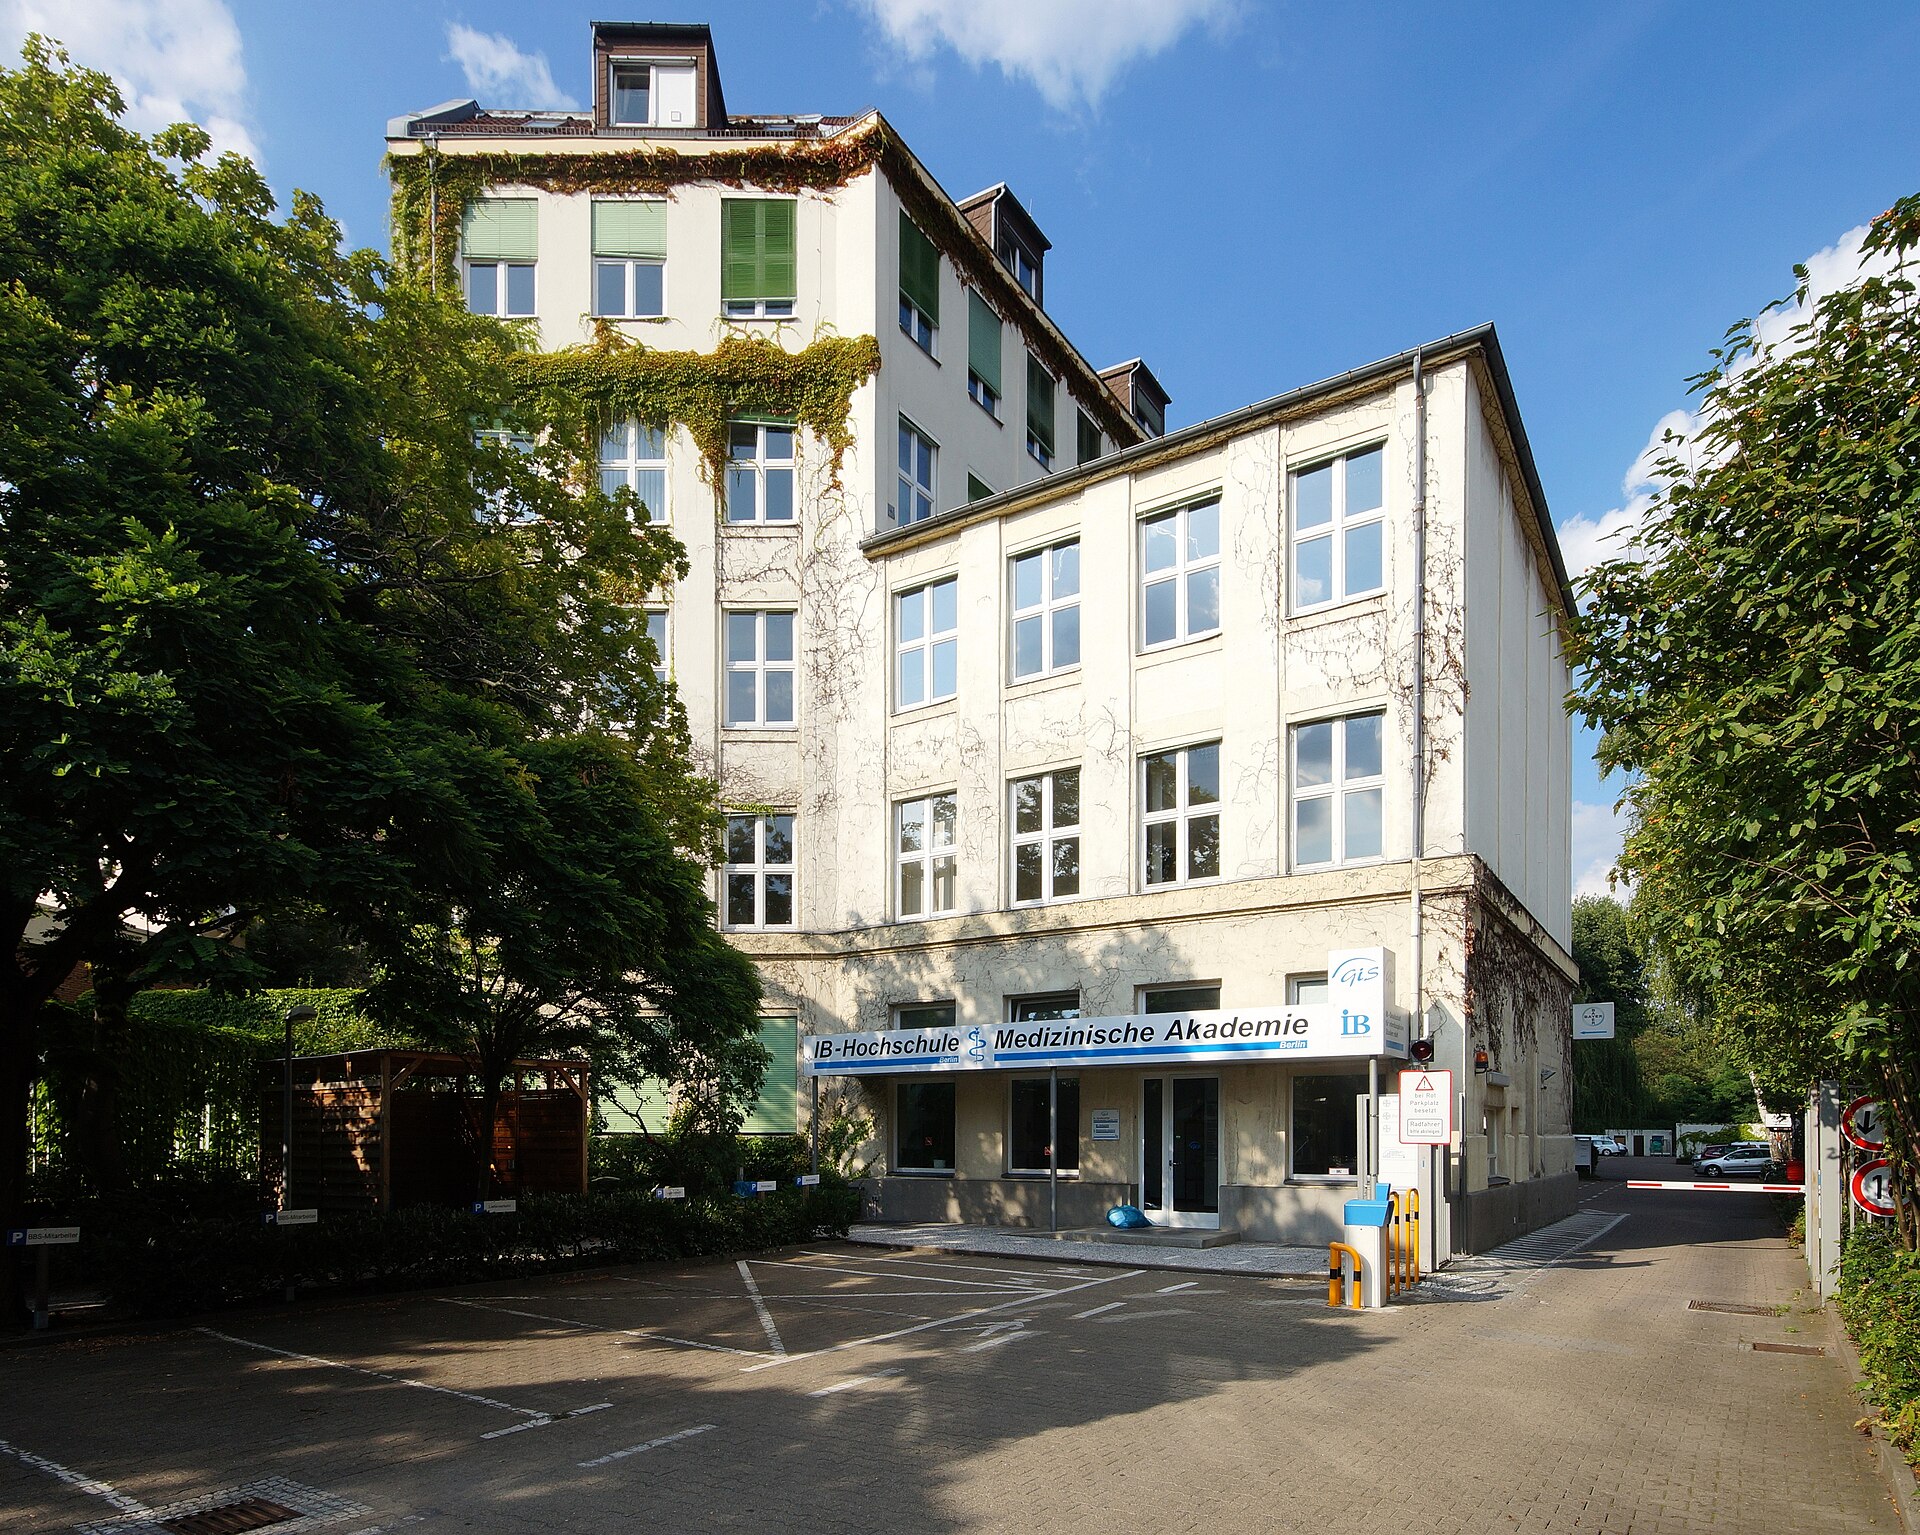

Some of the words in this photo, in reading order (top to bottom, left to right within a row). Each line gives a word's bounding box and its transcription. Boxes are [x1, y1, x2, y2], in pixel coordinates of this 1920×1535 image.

[994, 1022, 1155, 1050] Medizinische
[1163, 1013, 1309, 1041] Akademie
[814, 1033, 960, 1059] IB-Hochschule
[1279, 1040, 1306, 1049] Berlin
[475, 1203, 482, 1211] P
[266, 1214, 274, 1223] P
[12, 1232, 24, 1242] P
